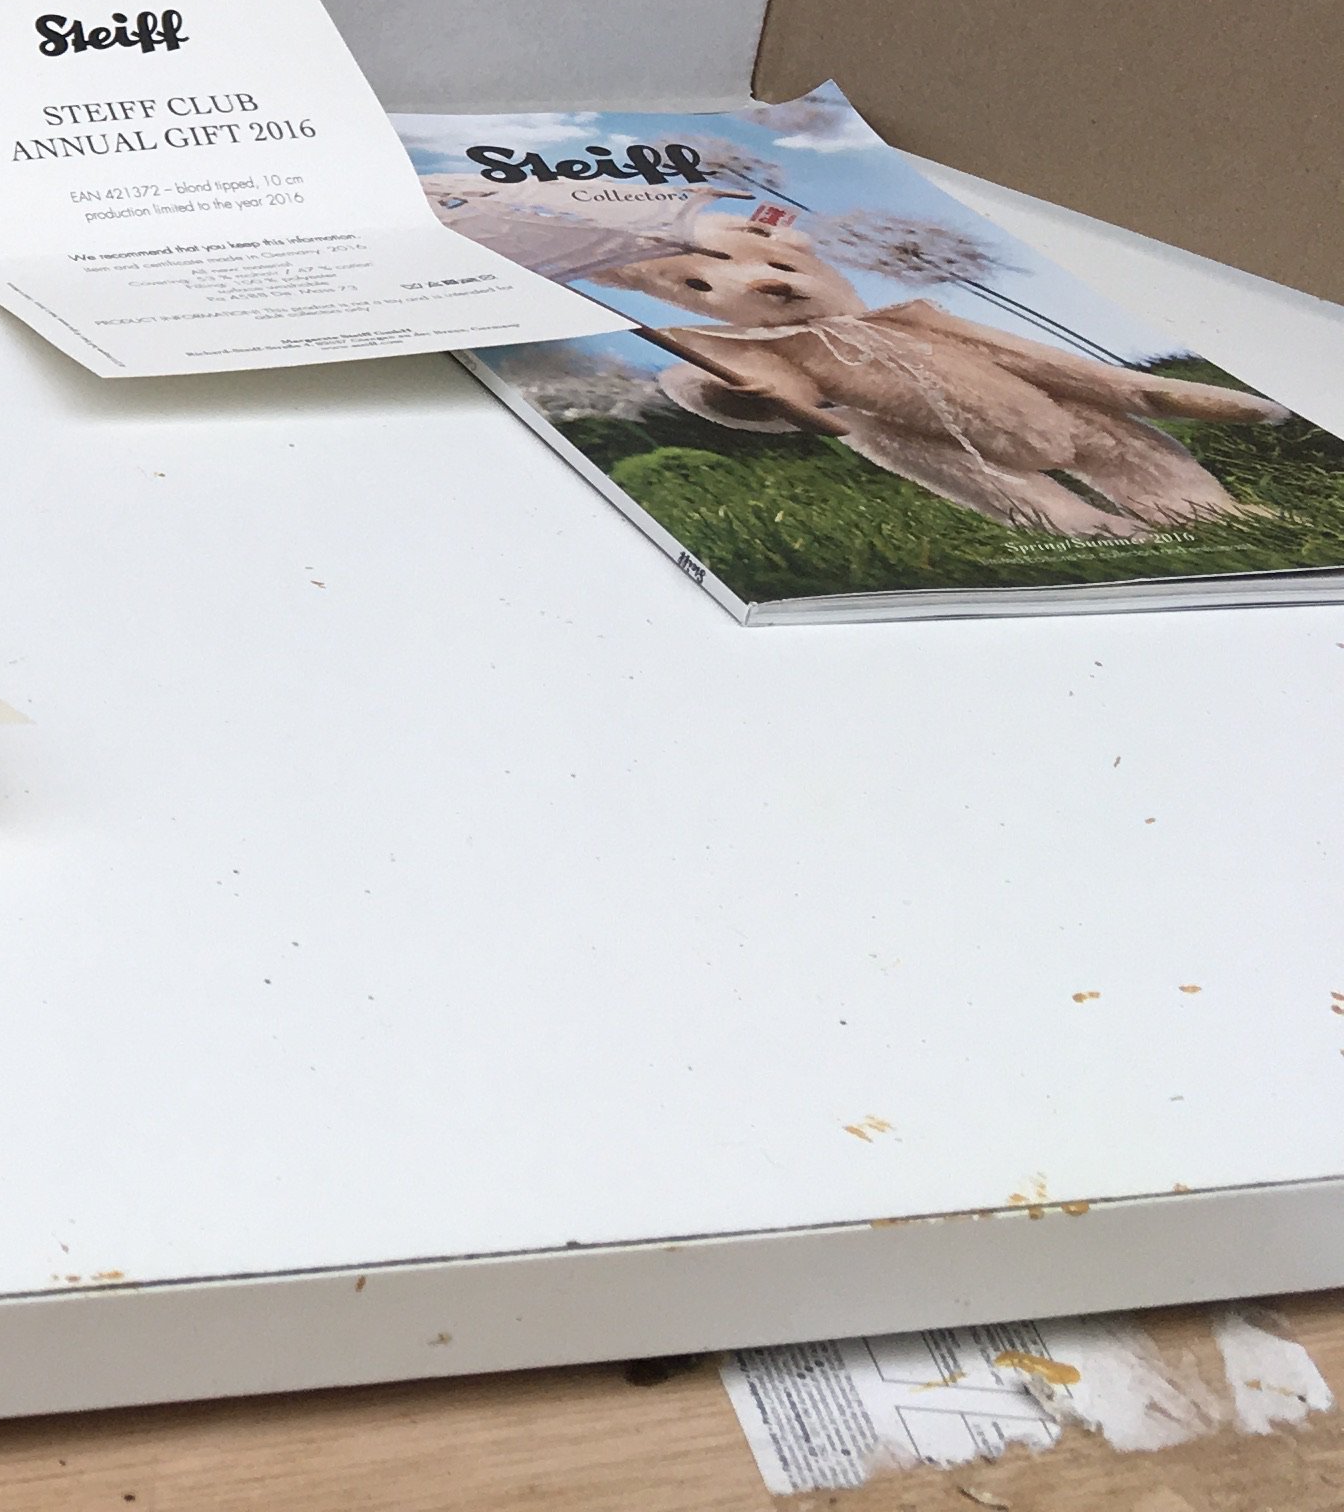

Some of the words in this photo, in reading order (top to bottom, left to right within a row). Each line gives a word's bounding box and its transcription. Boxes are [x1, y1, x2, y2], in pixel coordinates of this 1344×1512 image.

[34, 8, 190, 57] Steiff
[42, 98, 157, 127] STEIFF
[166, 92, 259, 117] CLUB
[11, 131, 158, 163] ANNUAL
[164, 123, 242, 149] GIFT
[248, 118, 317, 143] 2016
[465, 144, 720, 185] Steiff
[70, 190, 102, 204] EAN
[105, 184, 162, 200] 421372
[176, 180, 213, 194] blond
[214, 176, 260, 194] tipped,
[263, 174, 283, 187] 10
[284, 175, 305, 186] cm
[571, 189, 689, 203] Collectors
[84, 204, 151, 224] production
[153, 200, 196, 215] limited
[198, 198, 211, 211] to
[212, 197, 233, 210] the
[235, 197, 263, 211] year
[265, 191, 305, 207] 2016
[67, 252, 97, 263] We
[99, 245, 174, 261] recommend
[175, 243, 200, 254] that
[202, 242, 226, 253] you
[228, 239, 261, 250] keep
[262, 236, 286, 247] this
[287, 233, 362, 245] information.
